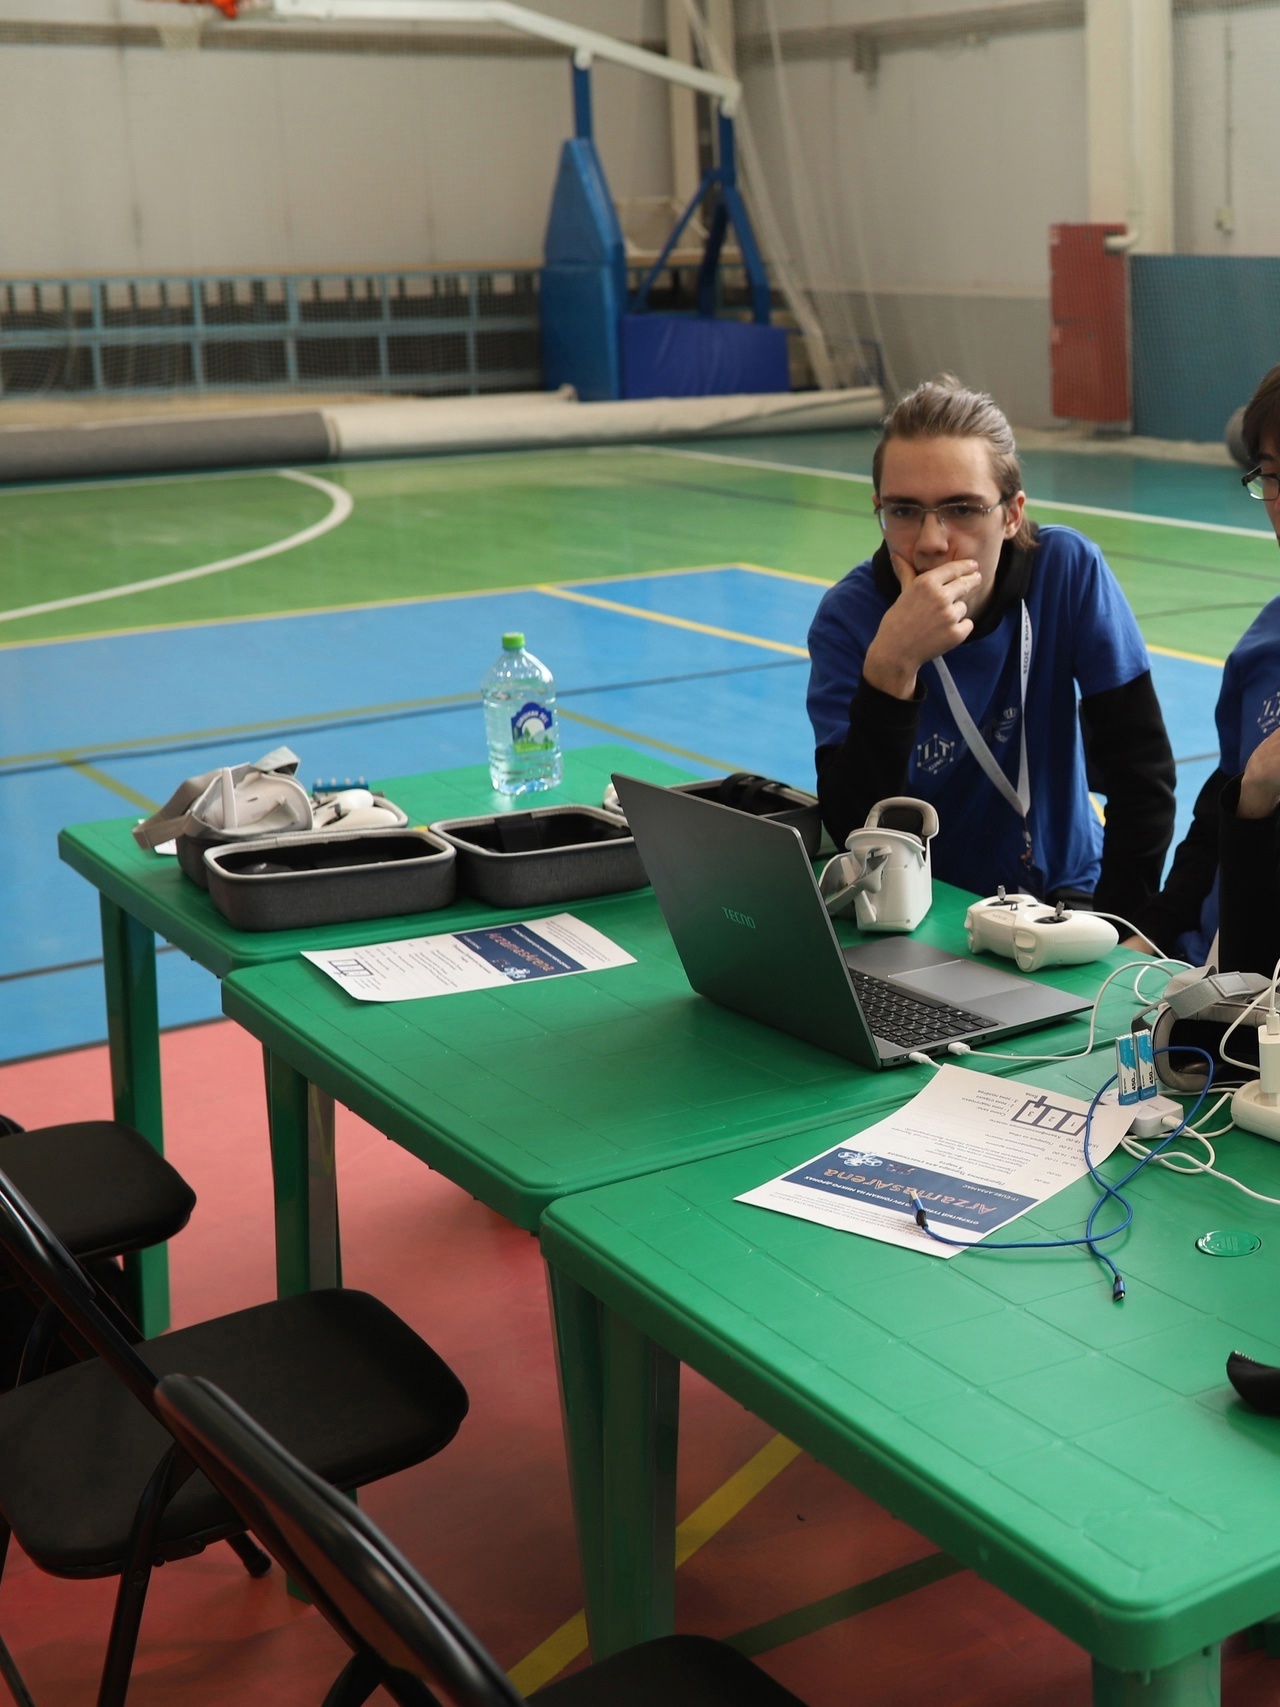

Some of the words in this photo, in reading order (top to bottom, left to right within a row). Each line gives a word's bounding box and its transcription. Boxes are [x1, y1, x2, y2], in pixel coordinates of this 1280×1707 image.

[721, 906, 756, 929] TECNO
[964, 1172, 1007, 1186] Программа
[818, 1167, 998, 1217] ArzamasArena
[939, 1212, 980, 1225] ОТКРЫТЫЙ
